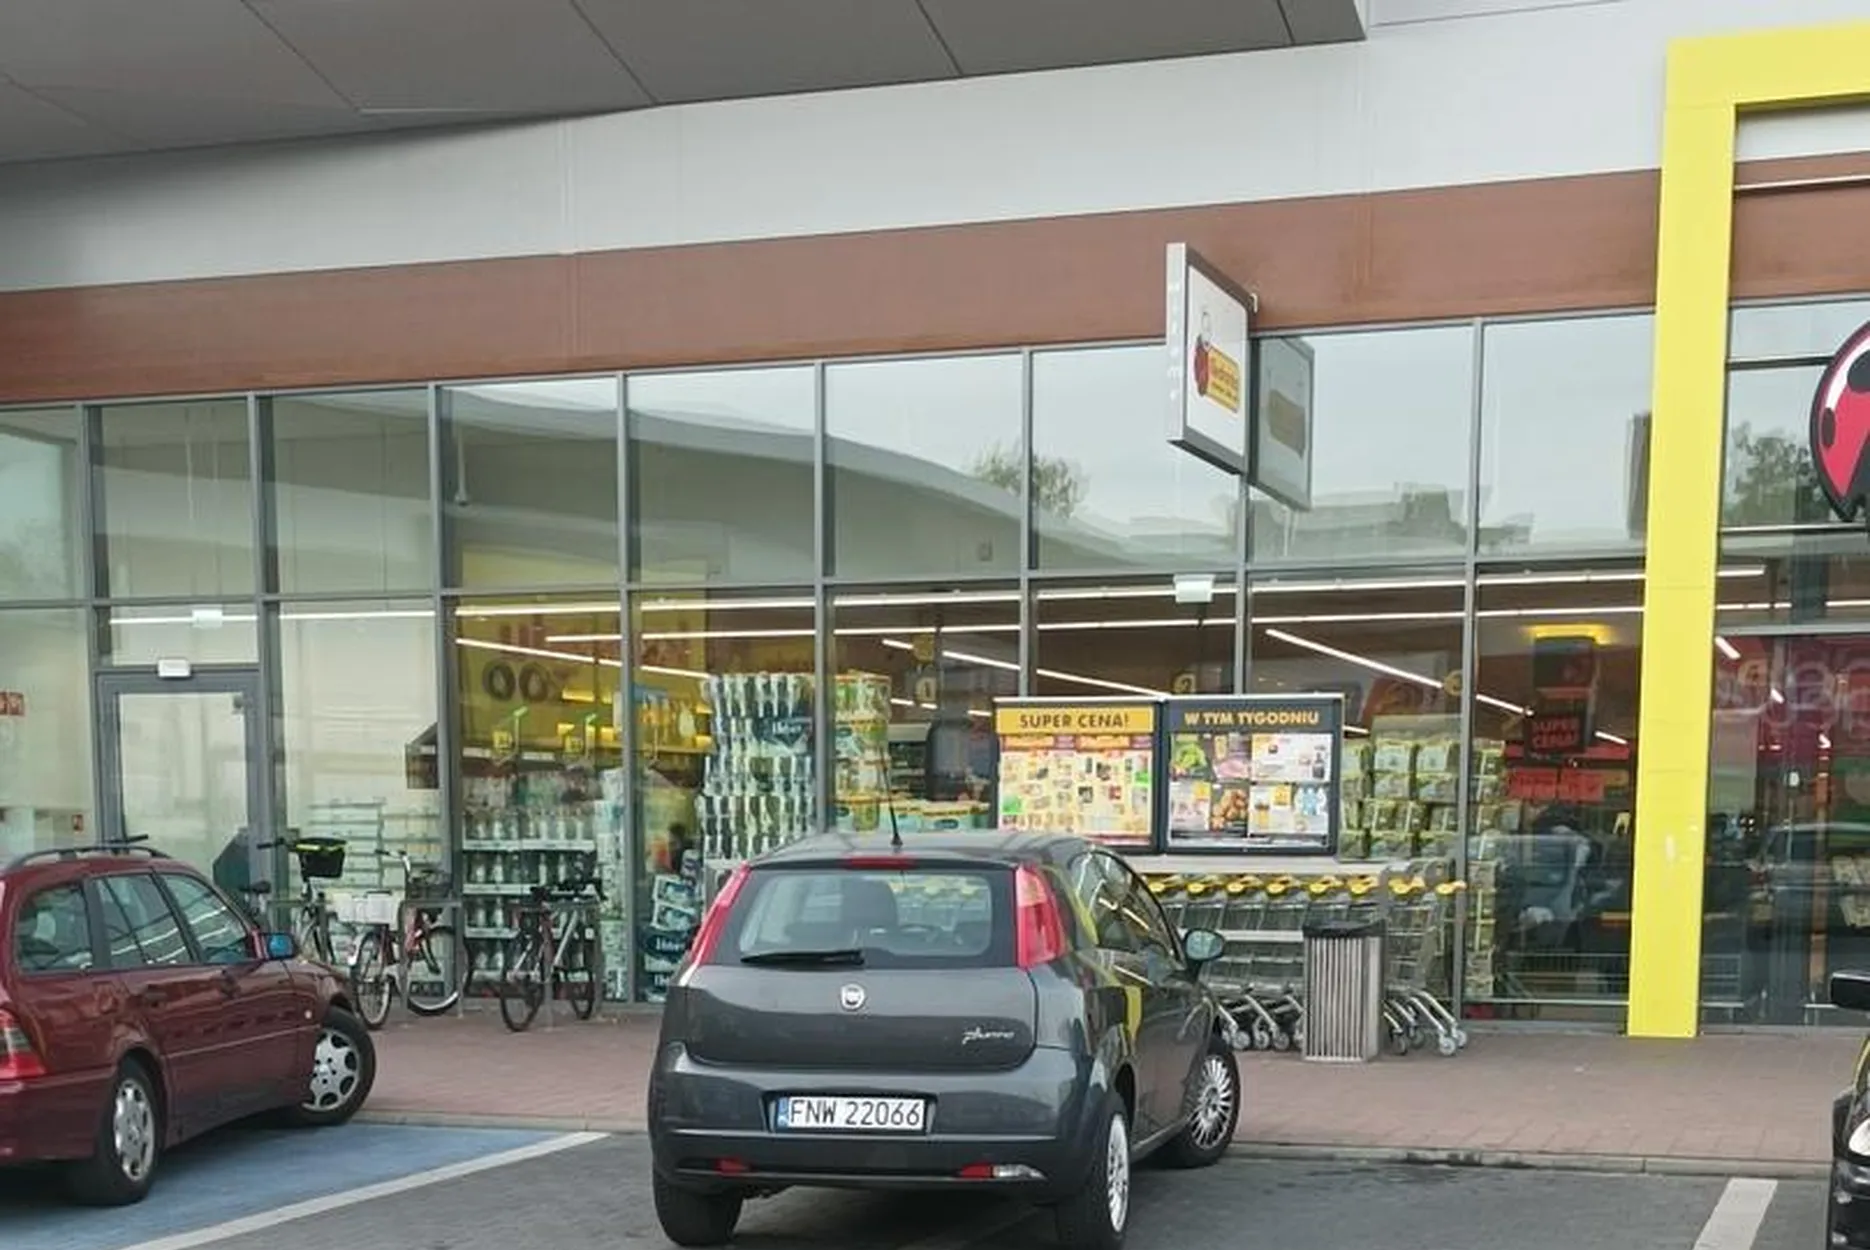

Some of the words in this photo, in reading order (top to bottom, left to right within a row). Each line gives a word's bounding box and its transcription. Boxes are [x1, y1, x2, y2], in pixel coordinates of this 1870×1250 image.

[1019, 714, 1072, 729] SUPER
[1077, 714, 1130, 728] CENA!
[1184, 712, 1198, 725] W
[1203, 711, 1234, 725] TYM
[1238, 711, 1319, 725] TYGODNIU
[790, 1099, 837, 1124] FNW
[845, 1101, 921, 1127] 22066
